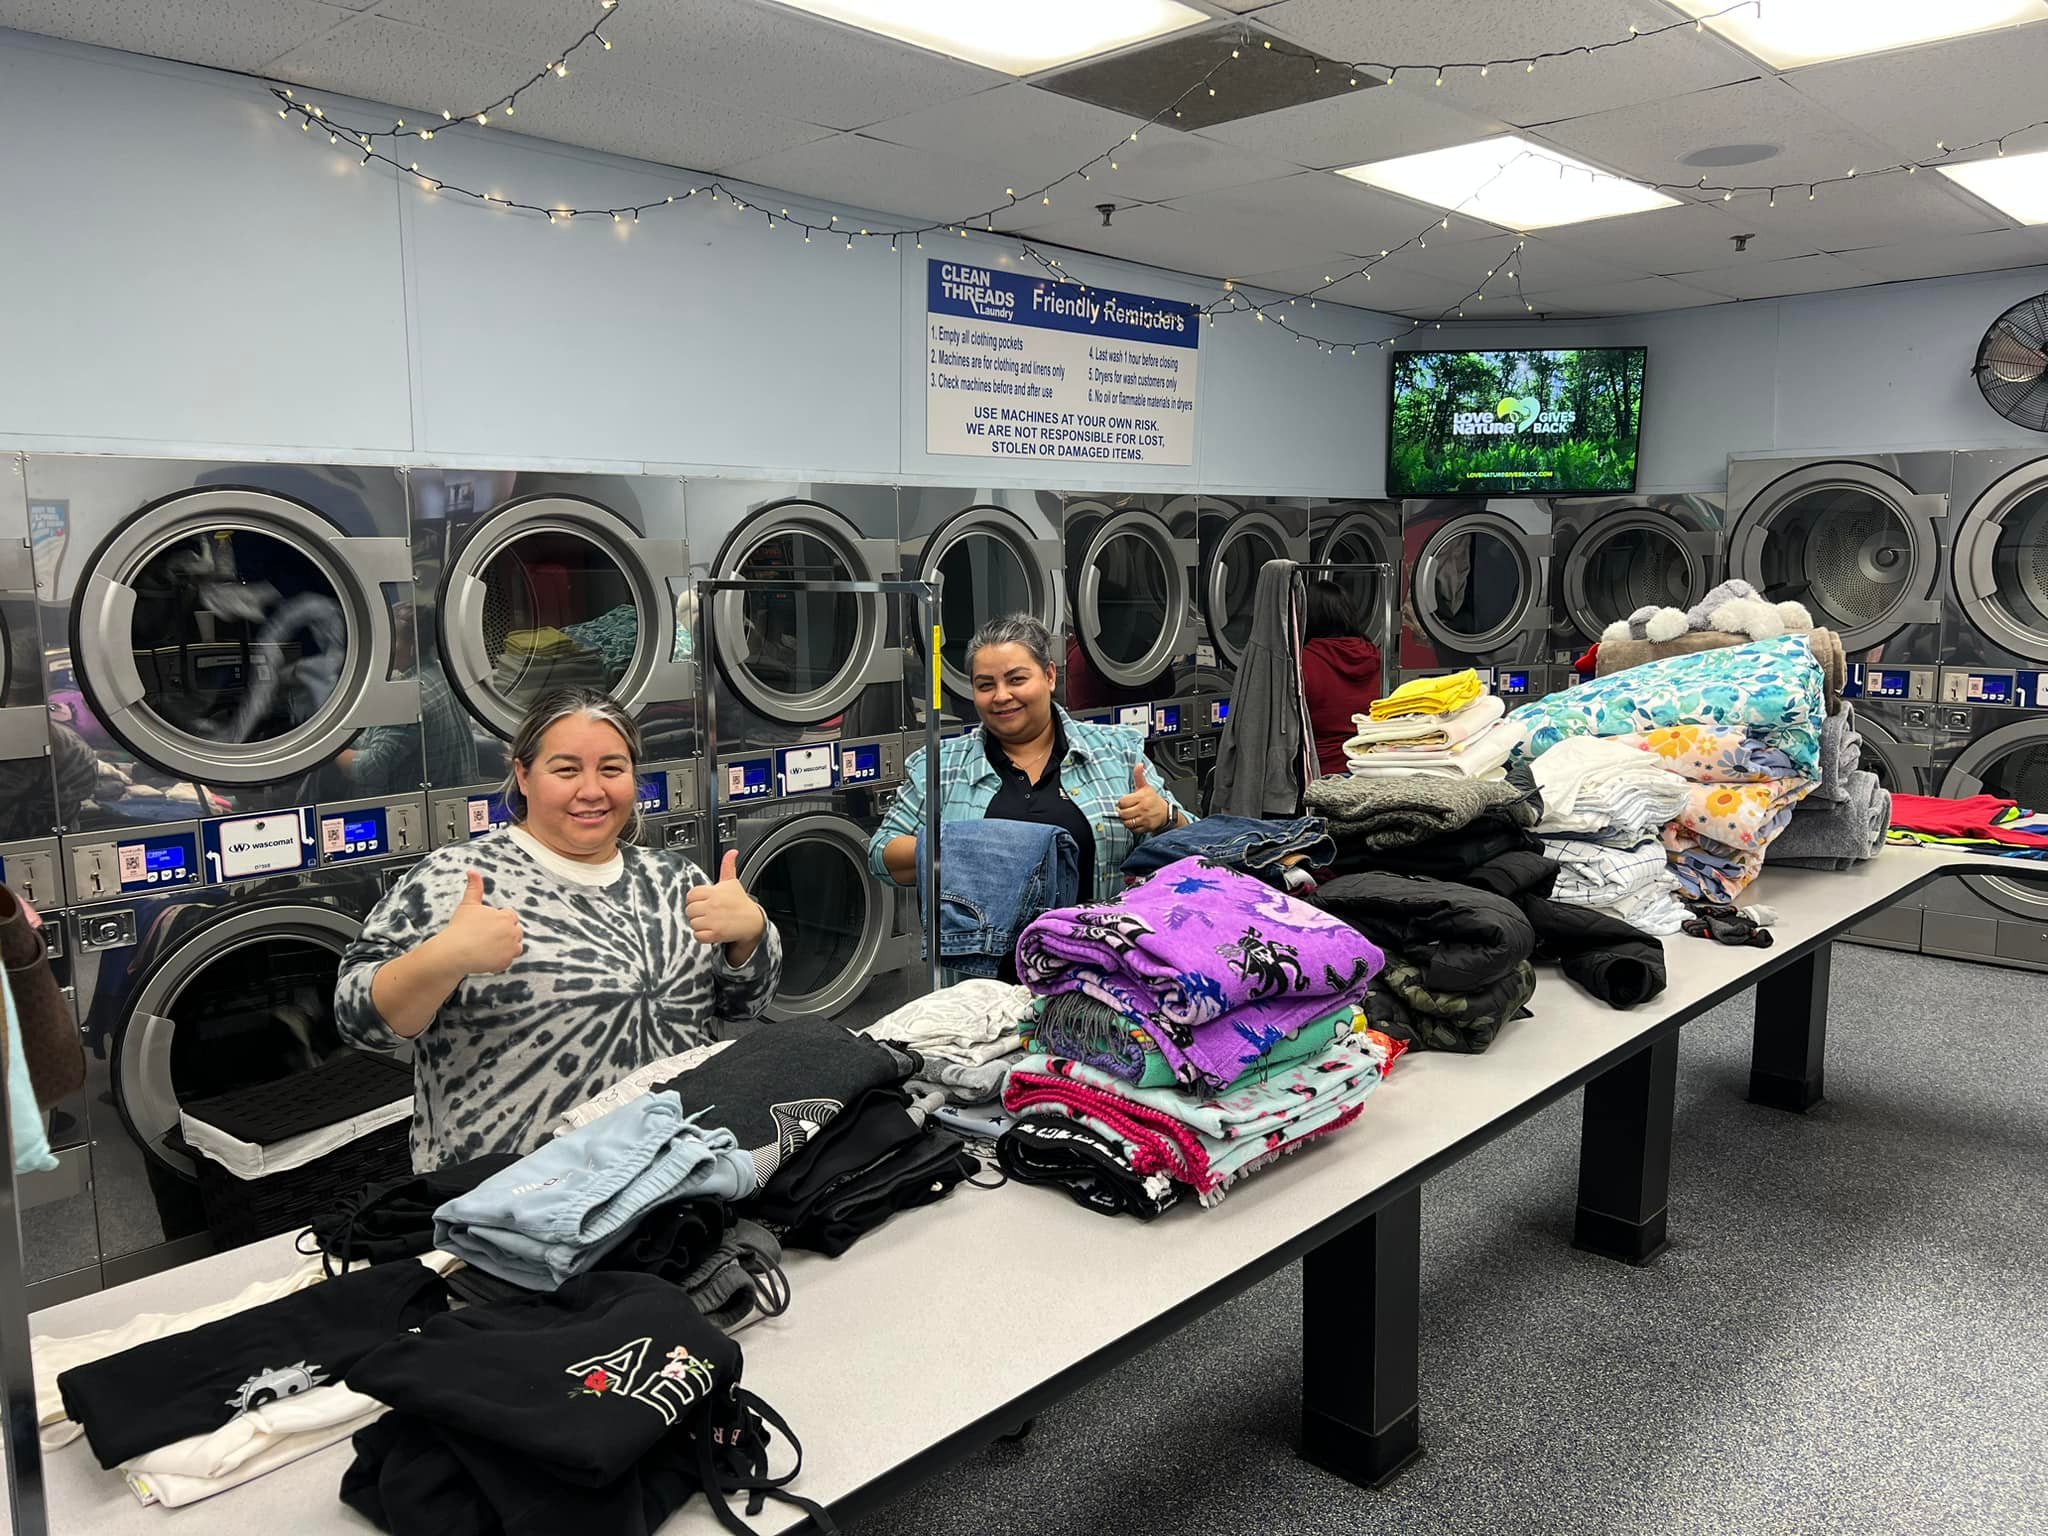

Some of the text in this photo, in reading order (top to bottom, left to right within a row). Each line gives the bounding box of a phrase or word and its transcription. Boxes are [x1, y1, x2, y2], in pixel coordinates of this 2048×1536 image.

[941, 264, 990, 287] CLEAN
[941, 281, 1015, 314] THREADS
[1033, 288, 1185, 331] Friendly Reminders
[980, 303, 1014, 320] Laundry
[931, 325, 1024, 351] 1. Empty all clothing pockets
[930, 349, 1065, 381] 2. Machines are for clothing and linens only
[1089, 346, 1094, 360] 4.
[1095, 347, 1108, 361] Last
[1109, 350, 1122, 363] wash
[1129, 352, 1141, 365] hour
[1142, 353, 1159, 367] before
[1160, 355, 1178, 372] closing
[931, 372, 1053, 398] 3. Check machines before and after use
[1095, 368, 1113, 385] Dryers
[1114, 370, 1122, 383] for
[1123, 372, 1137, 385] wash
[1138, 374, 1165, 389] customers
[1166, 376, 1177, 392] only
[1095, 389, 1102, 403] No
[1103, 390, 1111, 404] oil
[1112, 392, 1118, 404] or
[1119, 391, 1146, 407] flammable
[1147, 395, 1170, 409] materials
[1171, 396, 1176, 409] in
[1177, 396, 1193, 413] dryers
[973, 406, 1160, 432] USE MACHINES AT YOUR OWN RISK.
[1533, 422, 1568, 433] BACK
[1539, 411, 1576, 422] GIVES
[965, 422, 1165, 449] WE ARE NOT RESPONSIBLE FOR LOST,
[991, 440, 1144, 461] STOLEN OR DAMAGED ITEMS.
[252, 837, 294, 849] wascomat
[565, 1337, 713, 1426] AE
